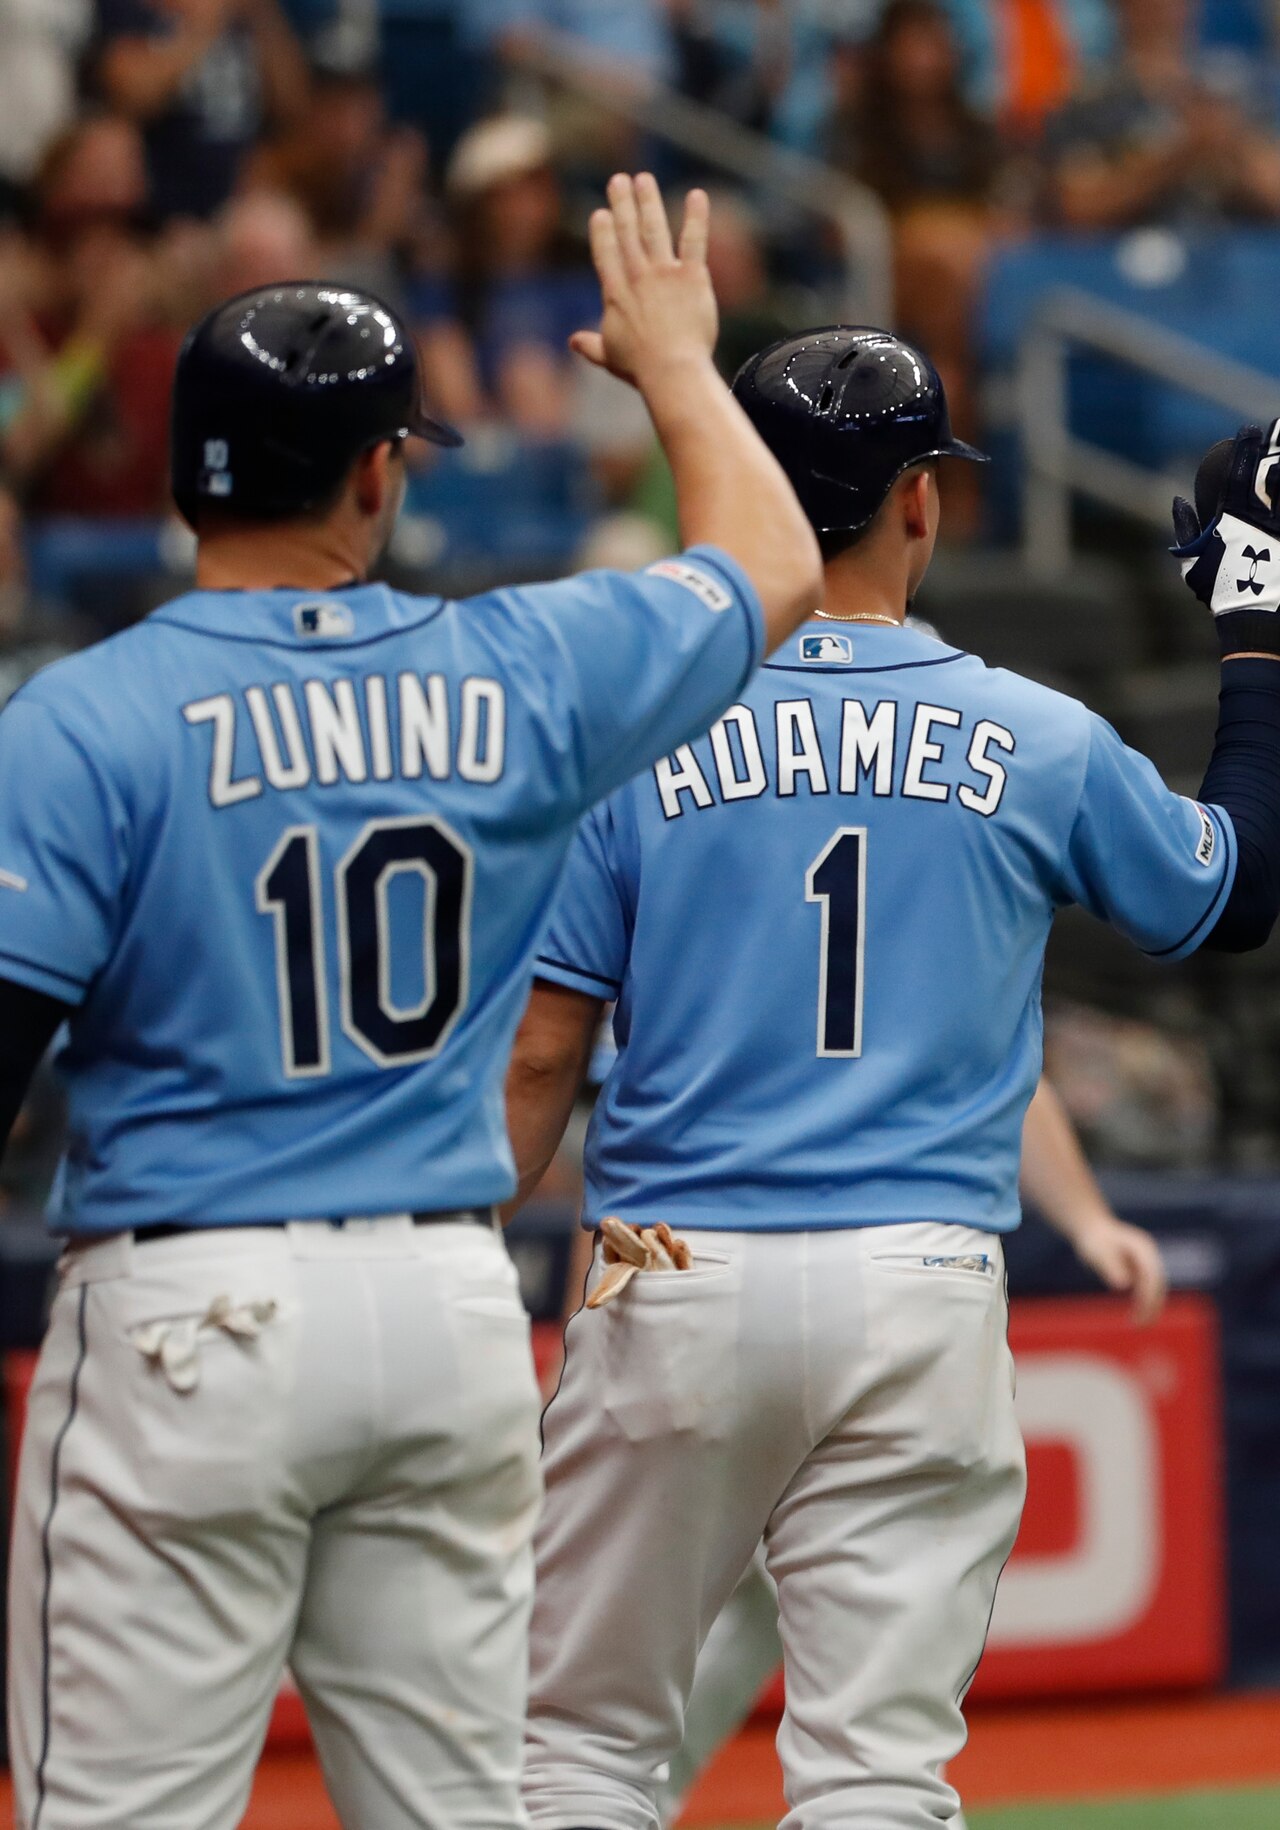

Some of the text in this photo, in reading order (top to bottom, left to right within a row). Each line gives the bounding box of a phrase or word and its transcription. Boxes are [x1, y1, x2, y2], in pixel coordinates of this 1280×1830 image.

[182, 672, 505, 807] ZUNINO
[653, 698, 1016, 819] ADAMES
[254, 813, 474, 1080] 10
[805, 826, 868, 1058] 1
